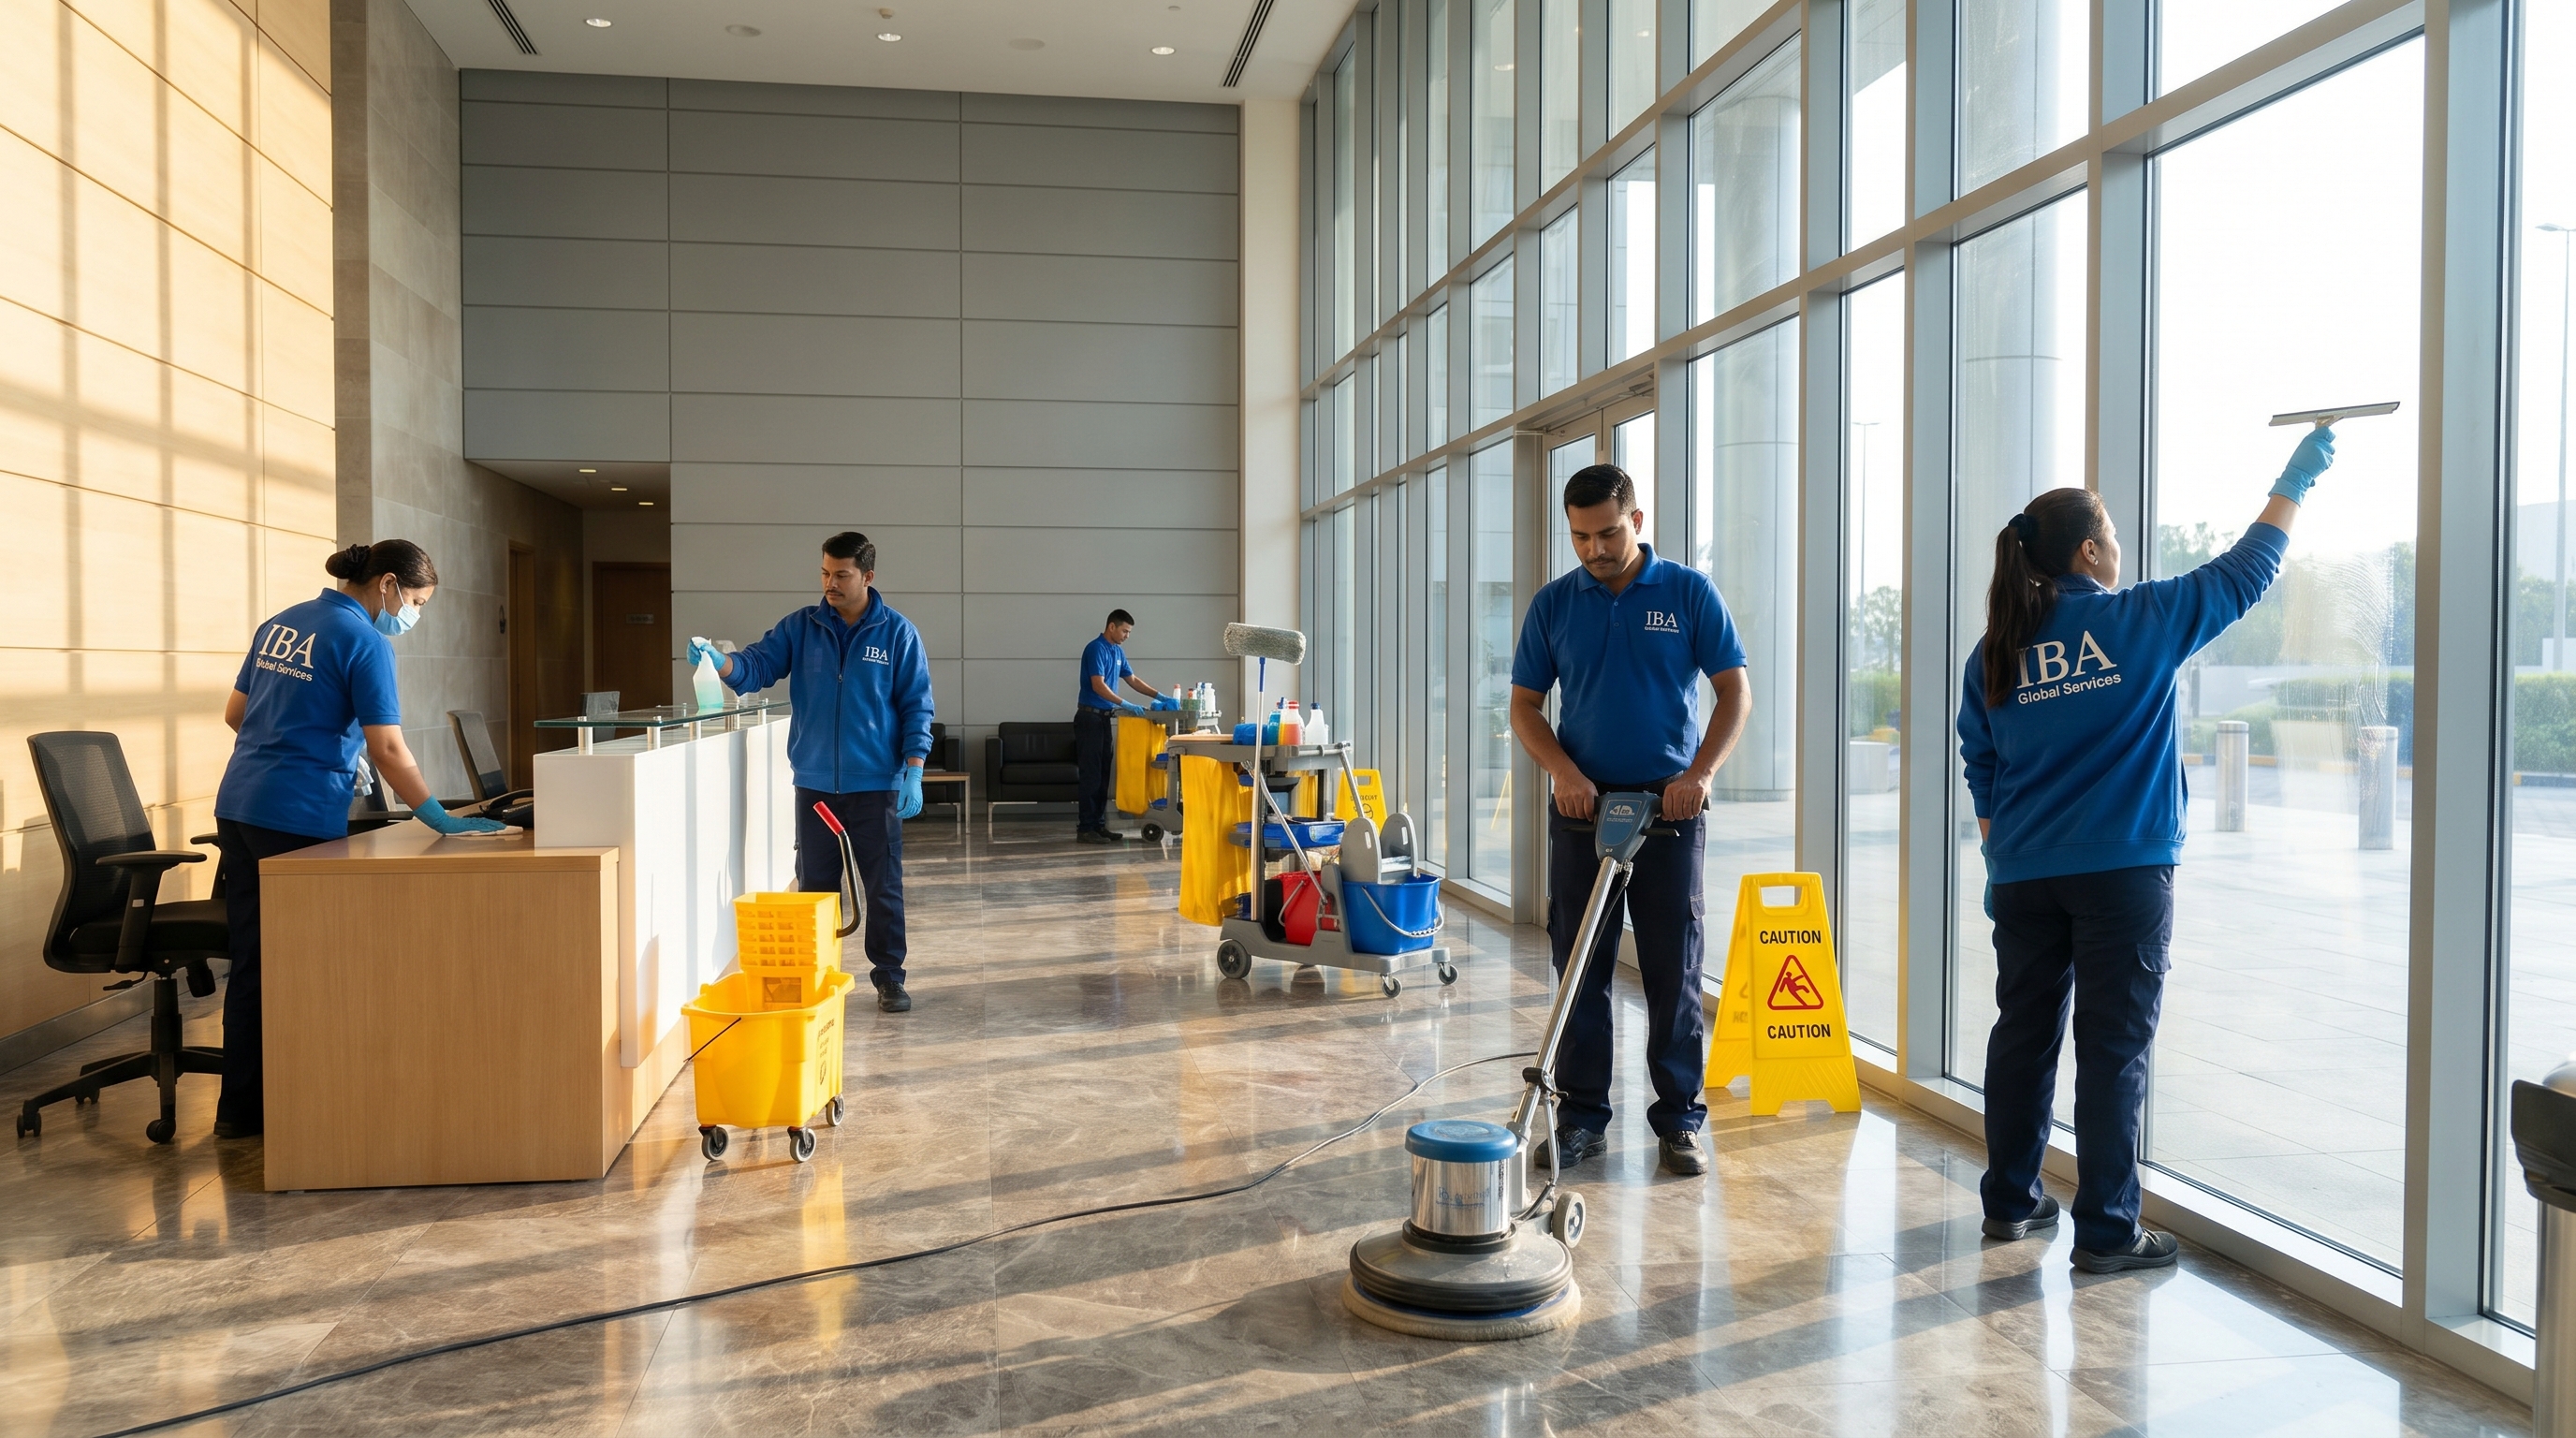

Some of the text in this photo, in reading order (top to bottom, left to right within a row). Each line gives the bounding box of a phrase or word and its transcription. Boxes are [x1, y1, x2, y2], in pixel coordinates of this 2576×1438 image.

[1646, 610, 1677, 627] IBA
[258, 624, 316, 669] IBA
[865, 646, 888, 661] IBA
[2015, 630, 2117, 689] IBA
[2018, 673, 2122, 704] Global Services
[1760, 930, 1822, 945] CAUTION
[1767, 1023, 1831, 1039] CAUTION
